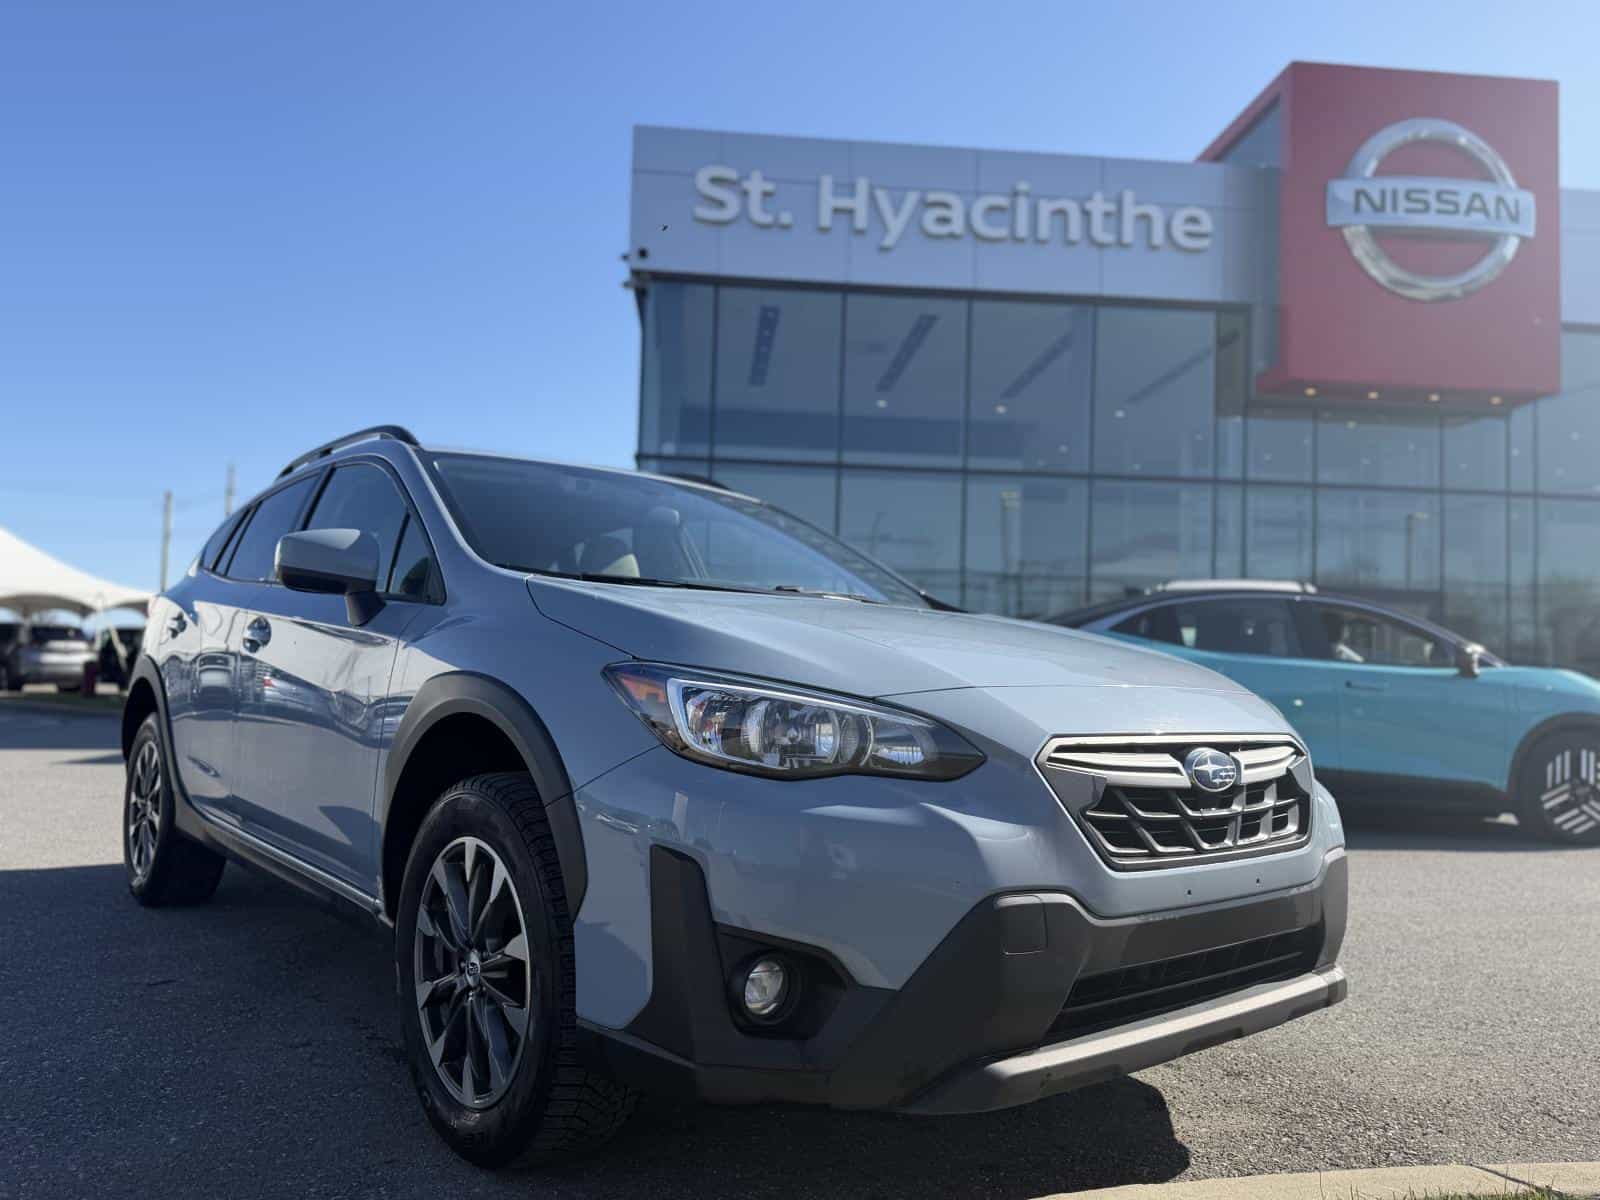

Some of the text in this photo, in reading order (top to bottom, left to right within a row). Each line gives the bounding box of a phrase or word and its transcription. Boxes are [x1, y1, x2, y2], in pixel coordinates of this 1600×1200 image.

[693, 165, 1214, 251] St. Hyacinthe
[1353, 188, 1521, 223] NISSAN
